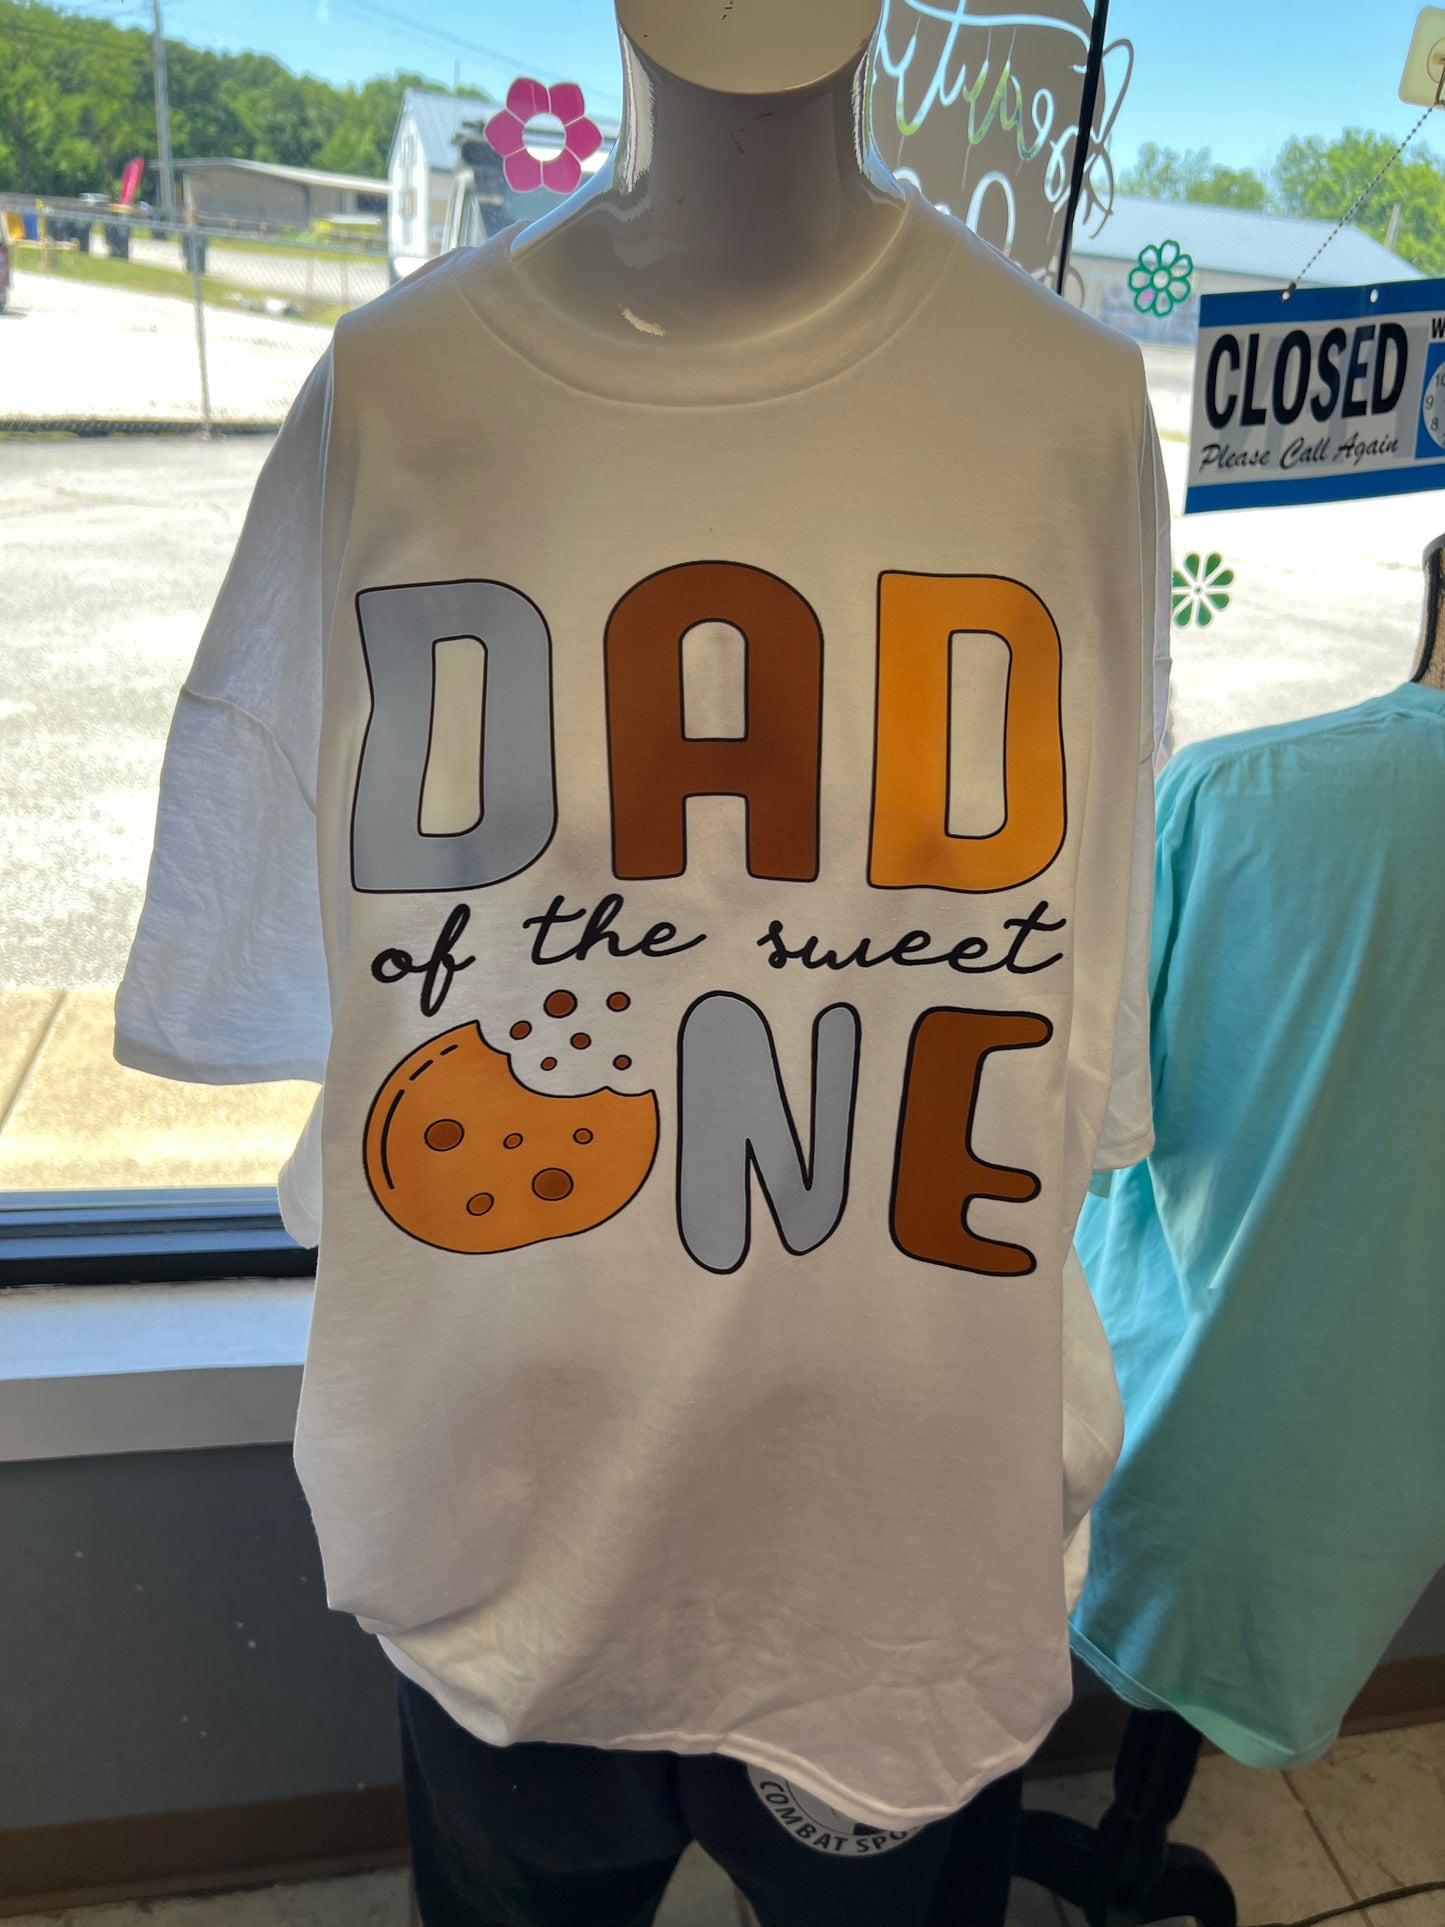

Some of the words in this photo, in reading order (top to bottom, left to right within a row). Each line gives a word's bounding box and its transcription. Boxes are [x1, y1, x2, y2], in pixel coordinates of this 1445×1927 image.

[1205, 323, 1408, 430] CLOSED
[1198, 443, 1270, 472] Please
[1279, 436, 1331, 470] Call
[1331, 431, 1399, 467] Again
[350, 560, 1067, 894] DAD
[371, 903, 476, 1017] of
[522, 893, 707, 966] the
[756, 900, 1067, 974] sweet
[760, 1781, 848, 1851] COMBAT
